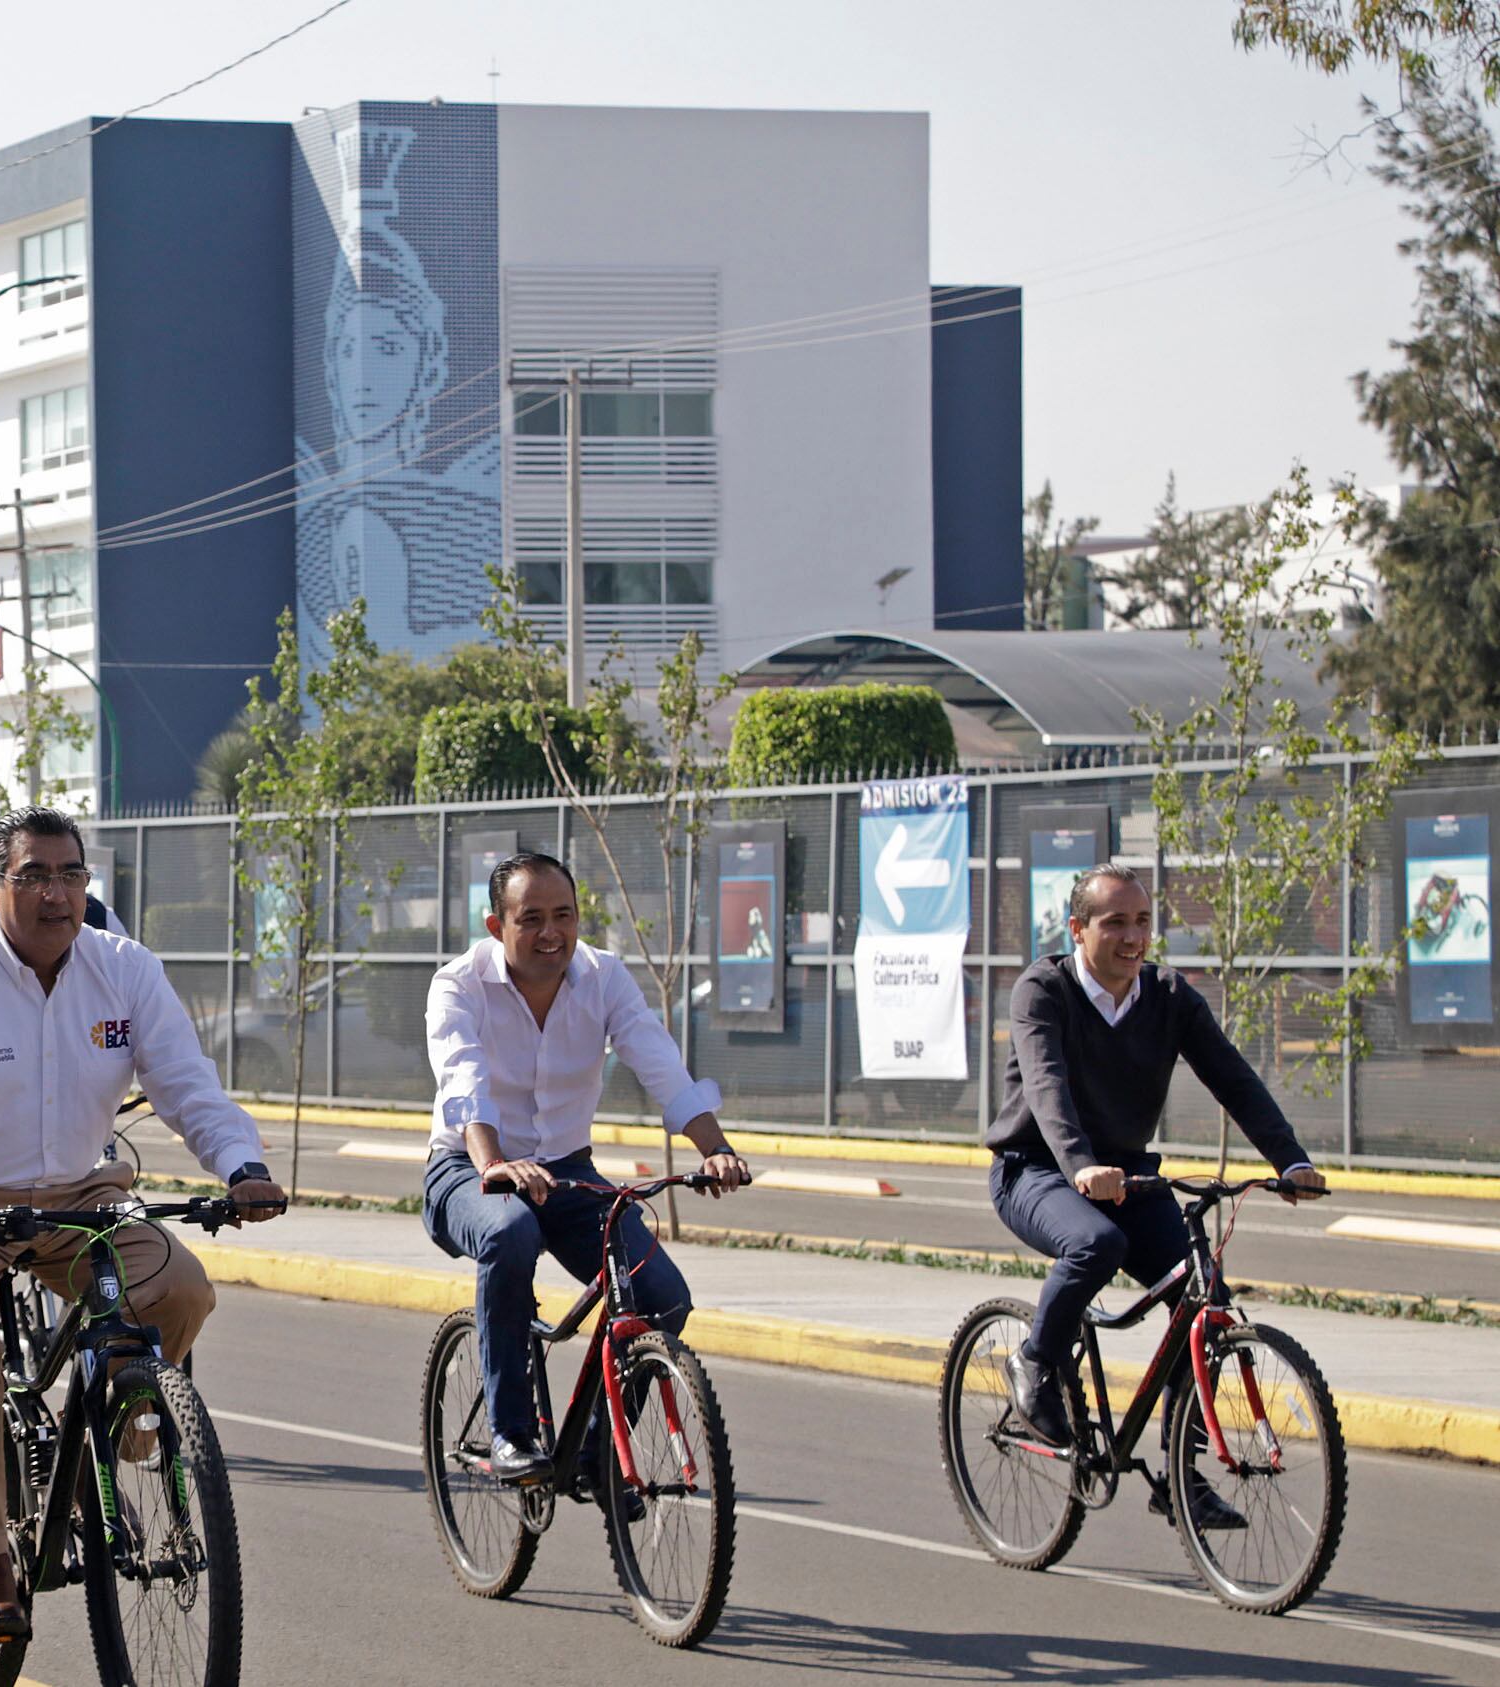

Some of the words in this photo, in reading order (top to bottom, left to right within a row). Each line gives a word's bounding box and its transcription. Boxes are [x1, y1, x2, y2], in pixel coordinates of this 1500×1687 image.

[873, 970, 909, 986] Cultura
[105, 1020, 130, 1035] PUE
[105, 1034, 130, 1049] BLA
[893, 1039, 925, 1060] BUAP
